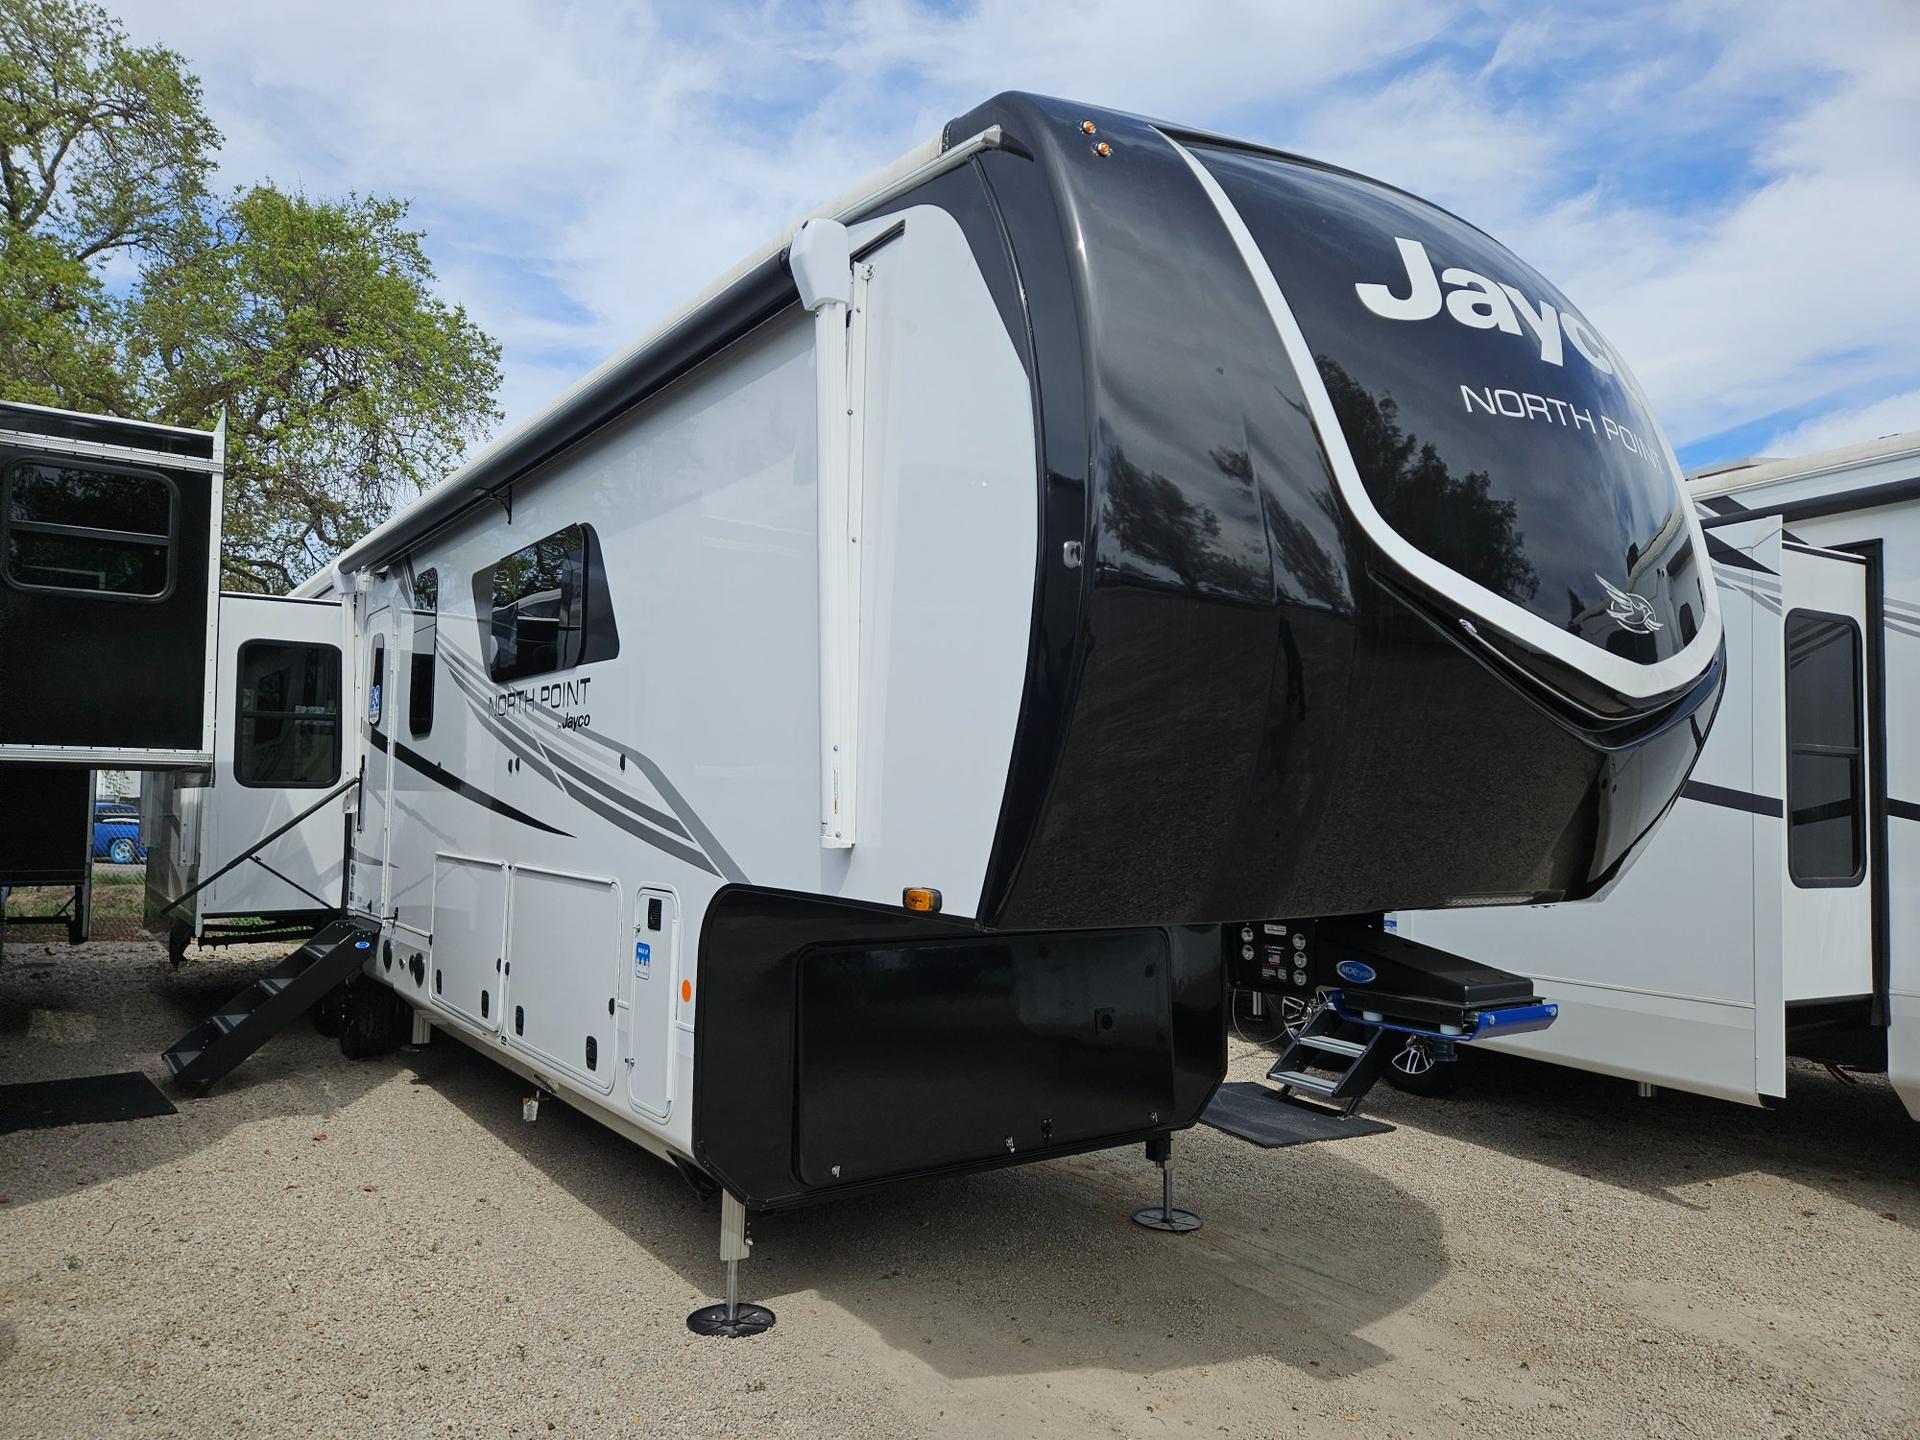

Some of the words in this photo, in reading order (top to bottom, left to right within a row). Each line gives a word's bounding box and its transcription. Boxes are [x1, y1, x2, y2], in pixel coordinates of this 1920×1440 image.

[1459, 384, 1597, 435] NORTH
[1601, 415, 1664, 473] POINT
[488, 688, 535, 718] NORTH
[541, 678, 591, 709] POINT
[562, 712, 591, 732] Jayco
